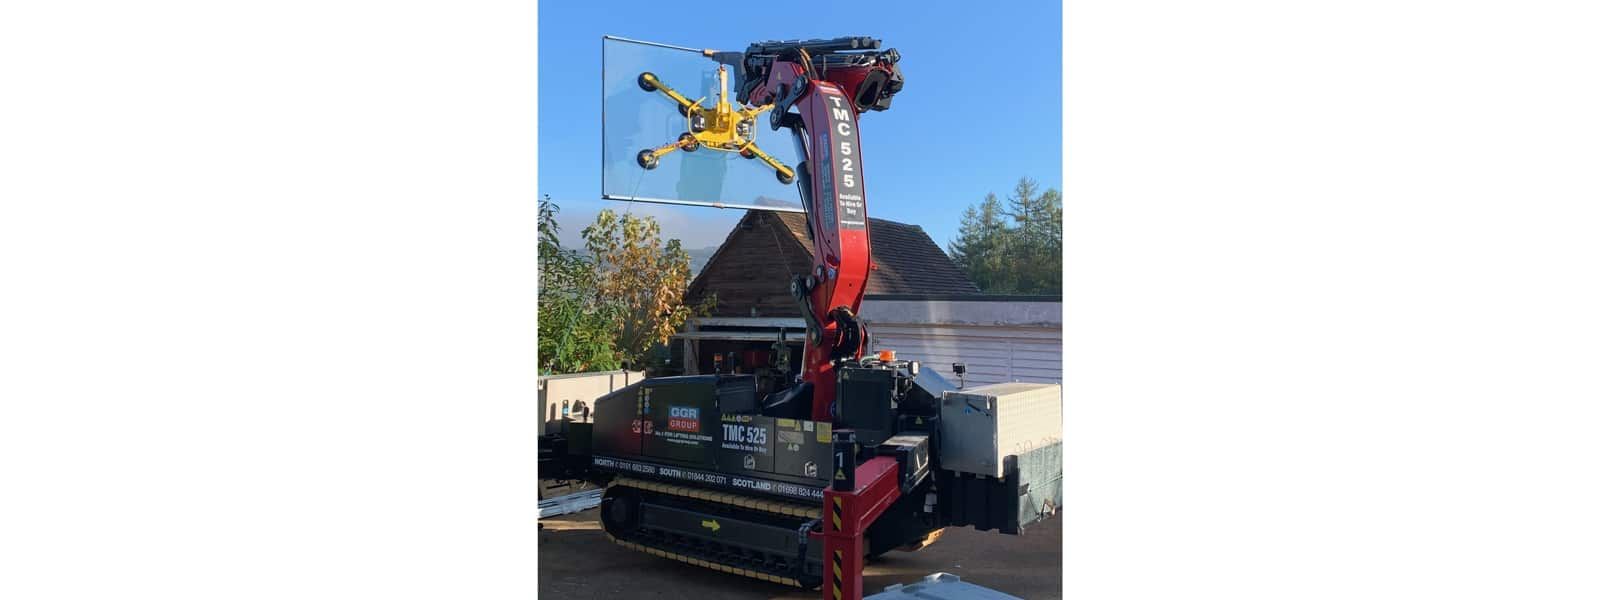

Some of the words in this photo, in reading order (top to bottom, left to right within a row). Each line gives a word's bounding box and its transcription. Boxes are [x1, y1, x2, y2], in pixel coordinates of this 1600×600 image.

[829, 96, 850, 136] TMC
[841, 142, 854, 188] 525
[671, 407, 697, 419] GGR
[670, 420, 697, 430] GROUP
[722, 423, 745, 442] TMC
[746, 427, 767, 444] 525
[722, 442, 740, 450] Available
[595, 458, 615, 468] NORTH
[835, 452, 844, 468] 1
[659, 467, 682, 478] SOUTH
[687, 472, 705, 481] 01844
[705, 473, 716, 482] 202
[716, 475, 727, 484] 071
[732, 478, 771, 490] SCOTLAND
[798, 487, 811, 497] 824
[811, 489, 825, 498] 444
